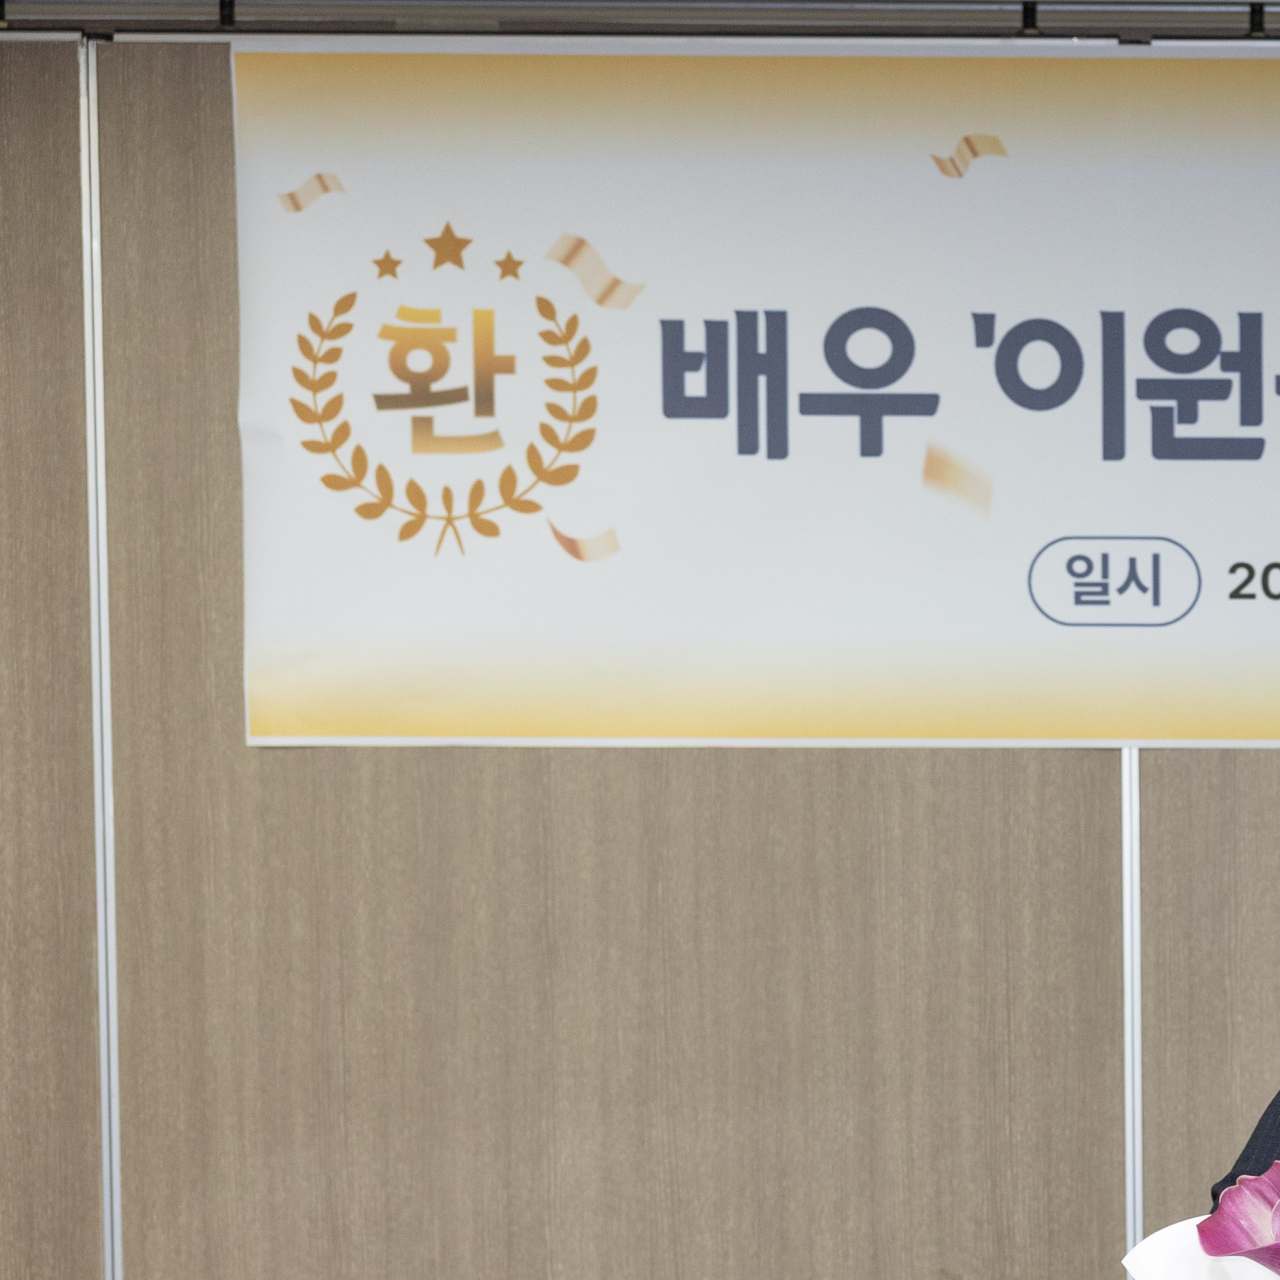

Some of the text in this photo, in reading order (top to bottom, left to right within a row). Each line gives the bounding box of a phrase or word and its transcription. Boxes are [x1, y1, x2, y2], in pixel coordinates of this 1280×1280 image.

[373, 304, 517, 455] 환
[661, 307, 940, 460] 배우
[1065, 552, 1162, 607] 일시
